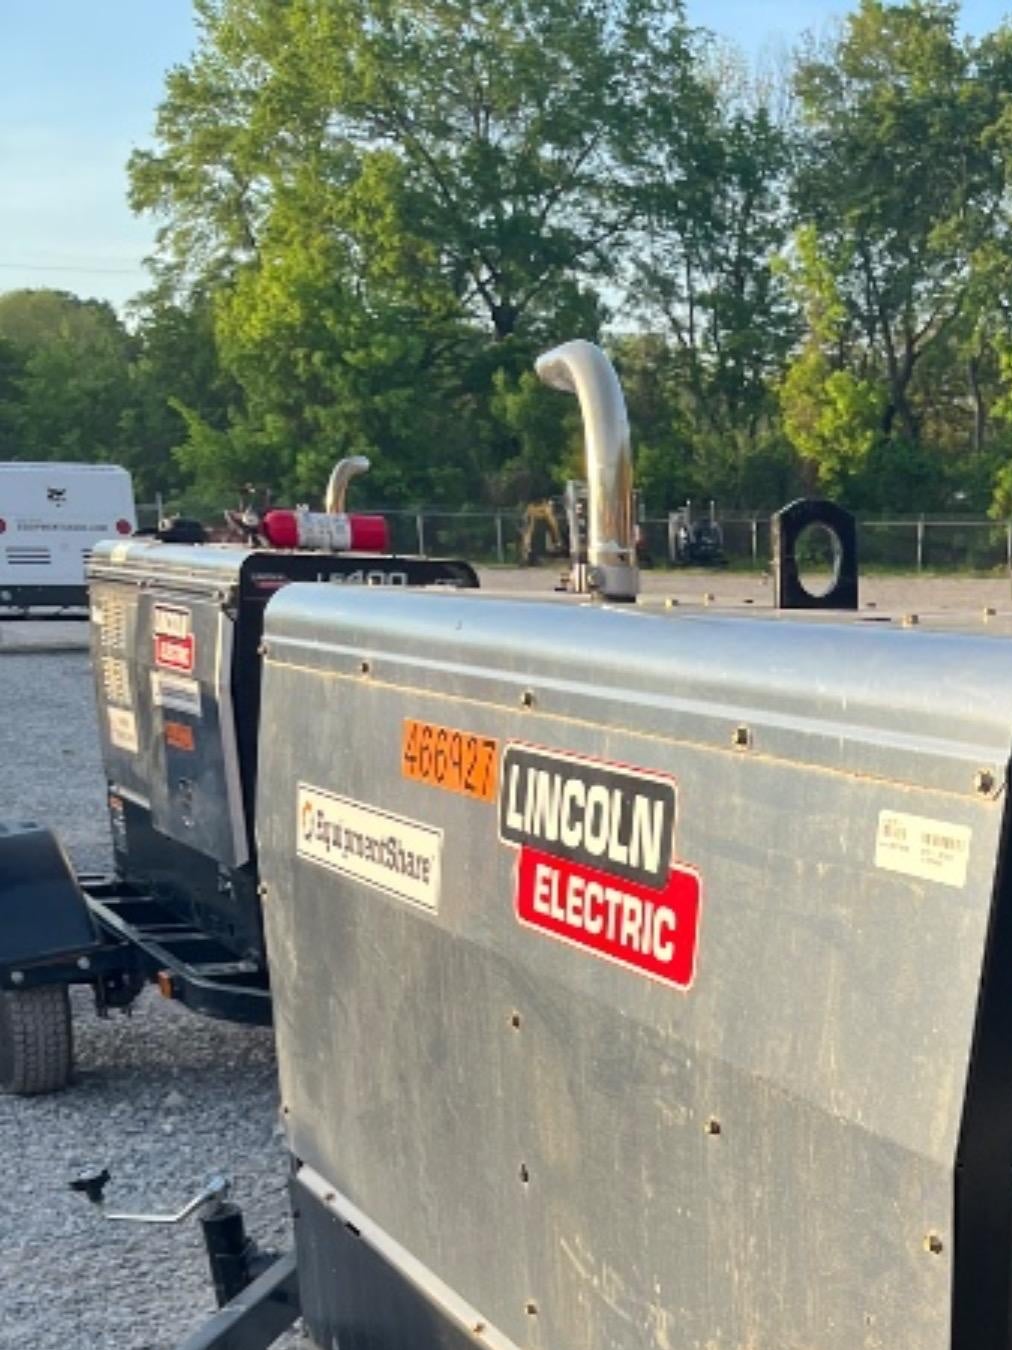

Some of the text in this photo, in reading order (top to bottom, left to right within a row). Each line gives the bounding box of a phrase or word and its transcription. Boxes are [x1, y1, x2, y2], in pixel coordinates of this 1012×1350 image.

[404, 723, 496, 796] 466927
[315, 809, 431, 885] EquipmentShare
[505, 763, 665, 874] LINCOLN
[531, 863, 677, 962] ELECTRIC
